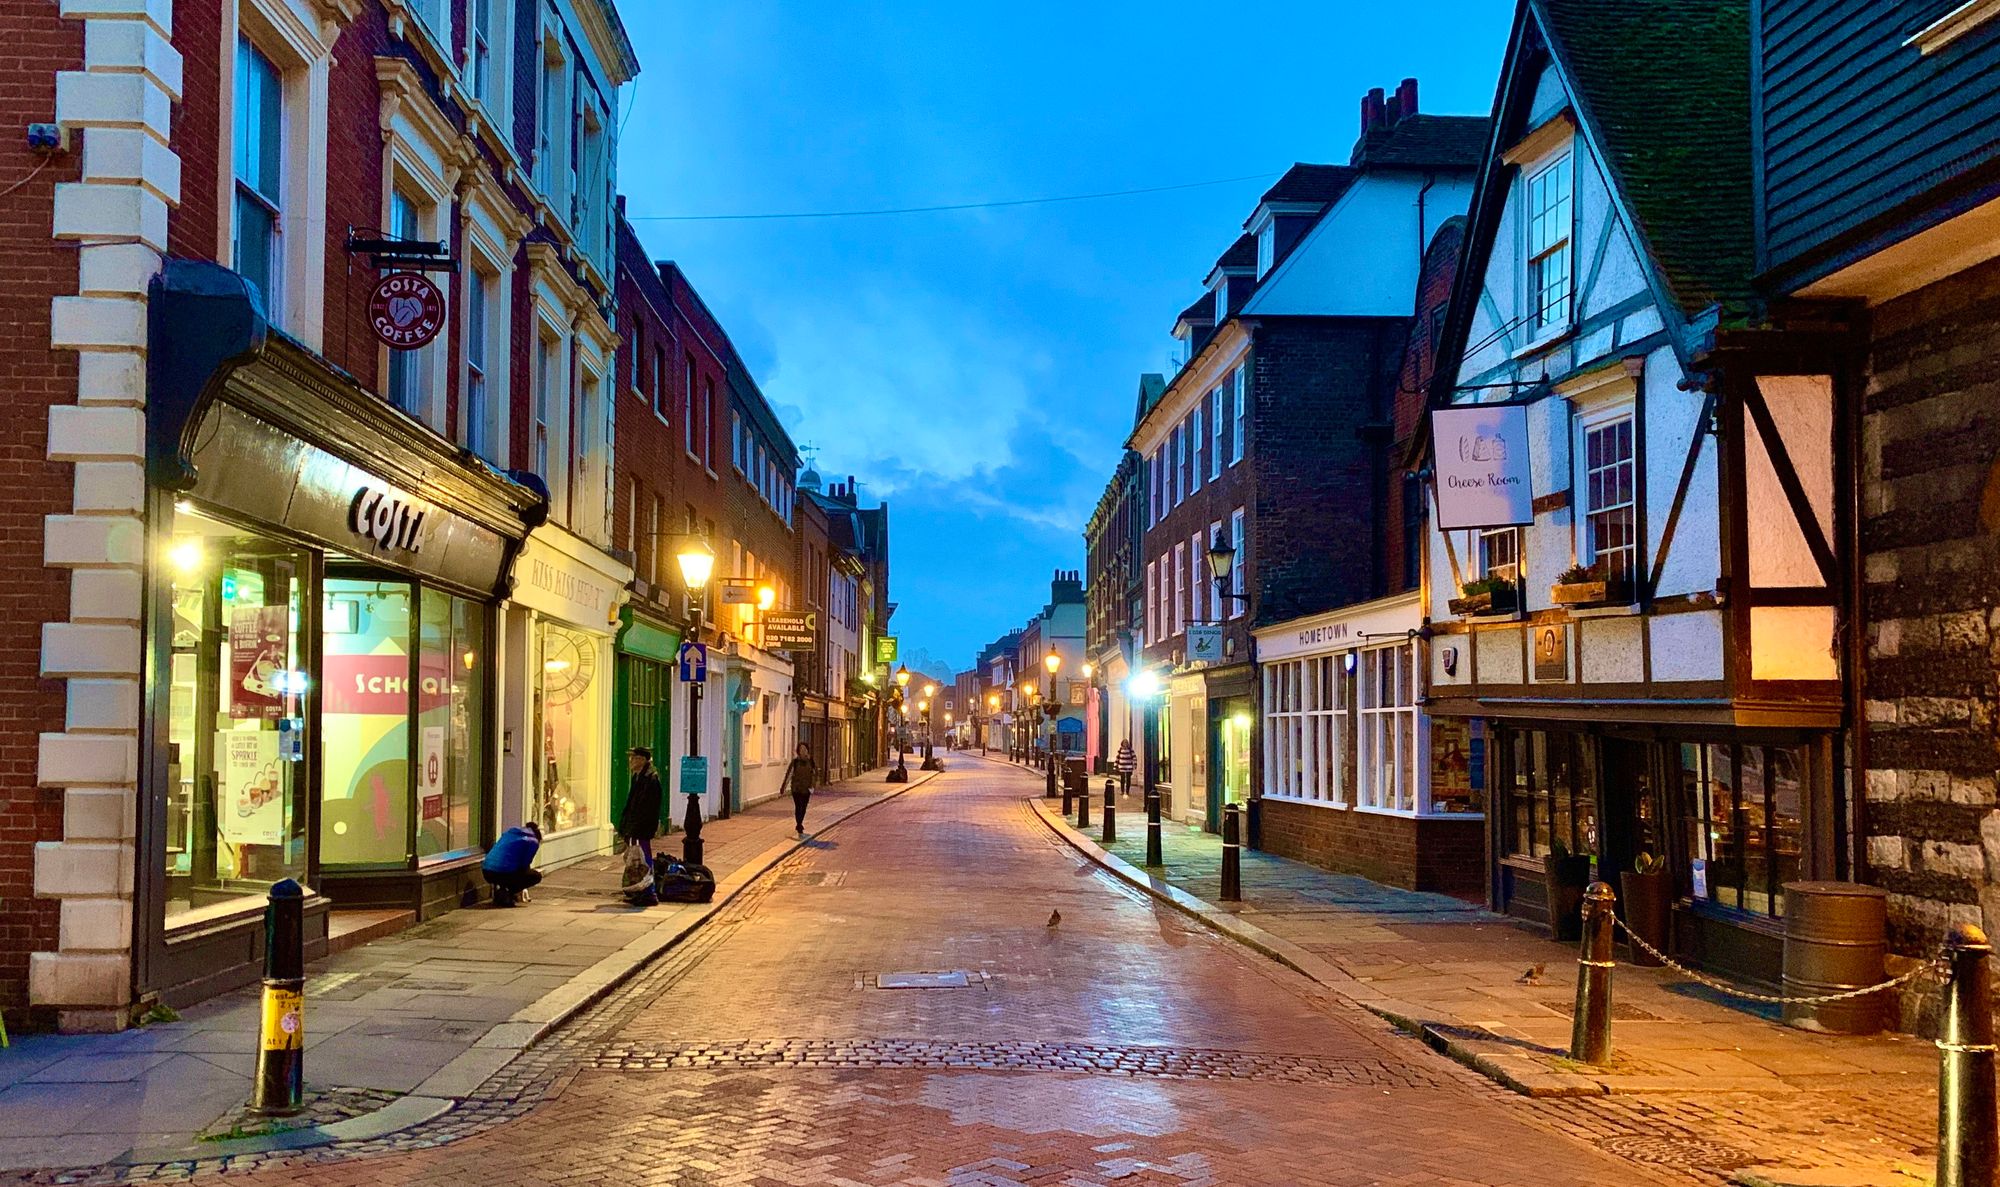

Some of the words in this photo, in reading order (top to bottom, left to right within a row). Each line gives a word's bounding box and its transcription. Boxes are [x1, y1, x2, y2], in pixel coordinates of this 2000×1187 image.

[380, 279, 430, 299] COSTA
[375, 316, 434, 342] COFFEE
[1448, 475, 1485, 489] Cheese
[1488, 472, 1521, 486] Room
[352, 486, 428, 554] COSTA
[531, 558, 553, 592] KISS
[554, 570, 575, 601] KISS
[234, 621, 257, 633] COFFEE
[1299, 622, 1348, 646] HOMETOWN
[231, 750, 257, 760] SPARKLE
